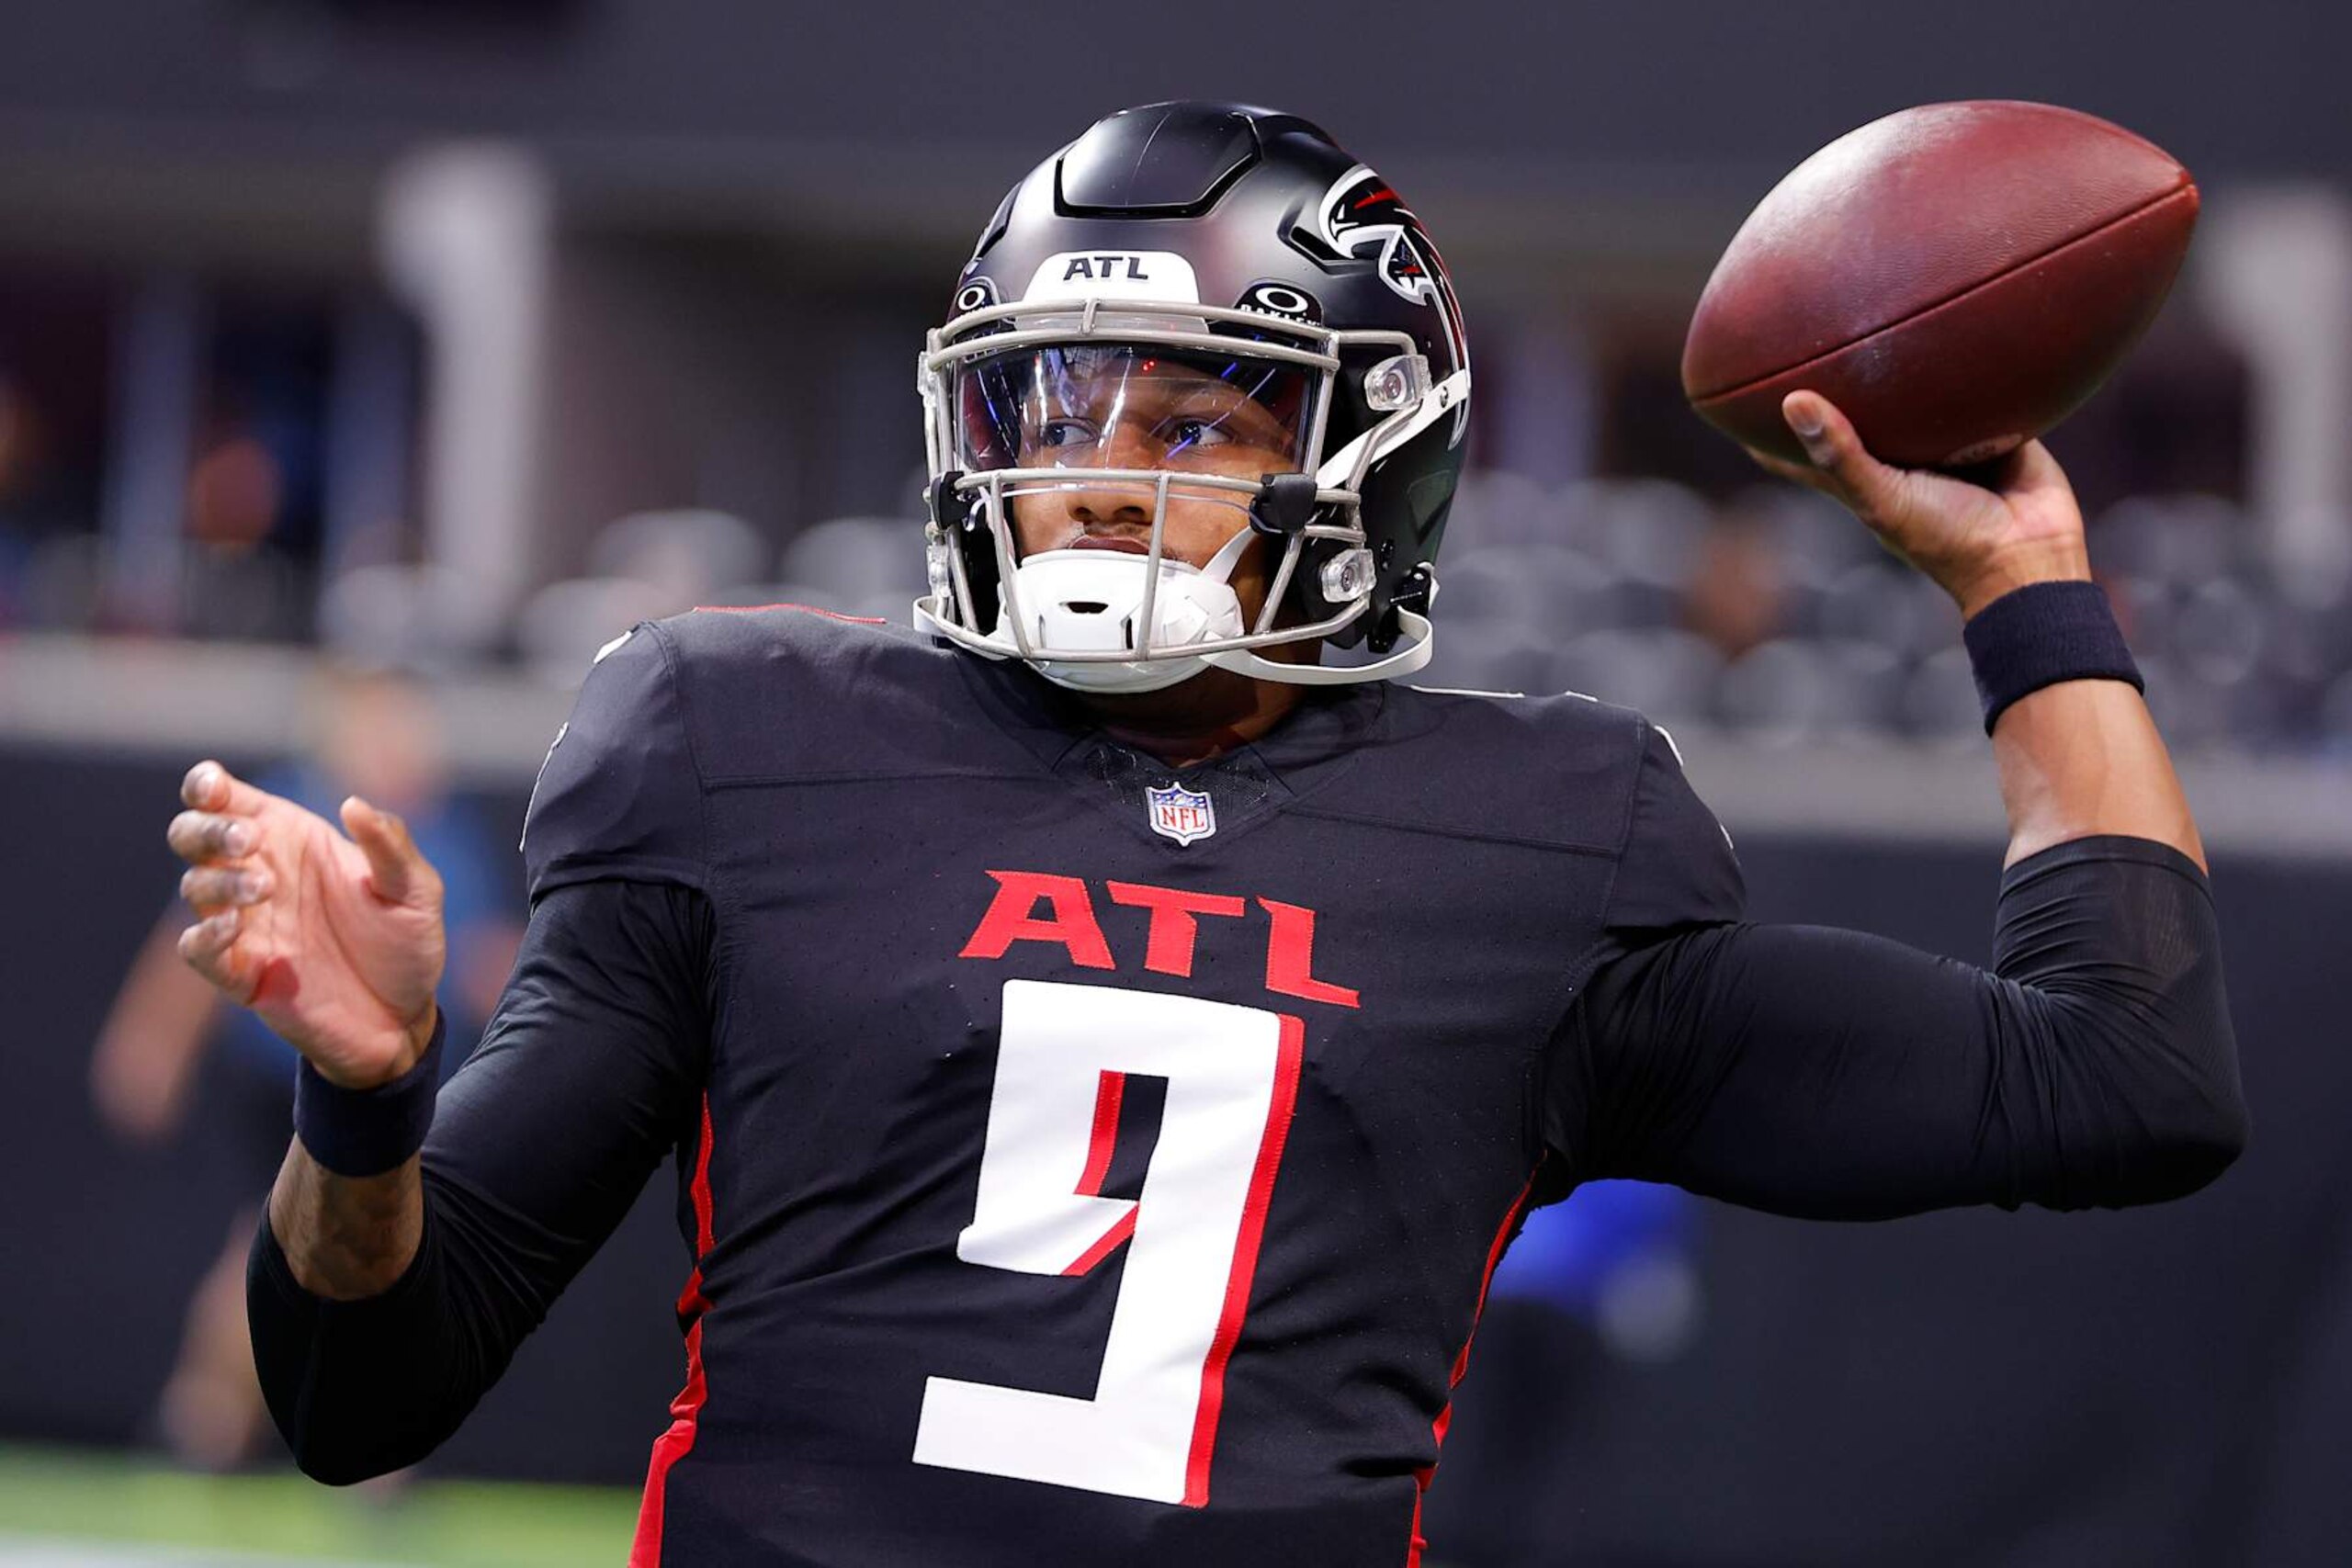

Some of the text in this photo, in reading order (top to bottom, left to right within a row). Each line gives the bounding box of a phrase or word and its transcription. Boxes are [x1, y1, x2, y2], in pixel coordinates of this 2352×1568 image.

[1063, 256, 1148, 281] ATL
[1161, 807, 1205, 830] NFL
[958, 870, 1362, 1009] ATL
[912, 978, 1306, 1509] 9
